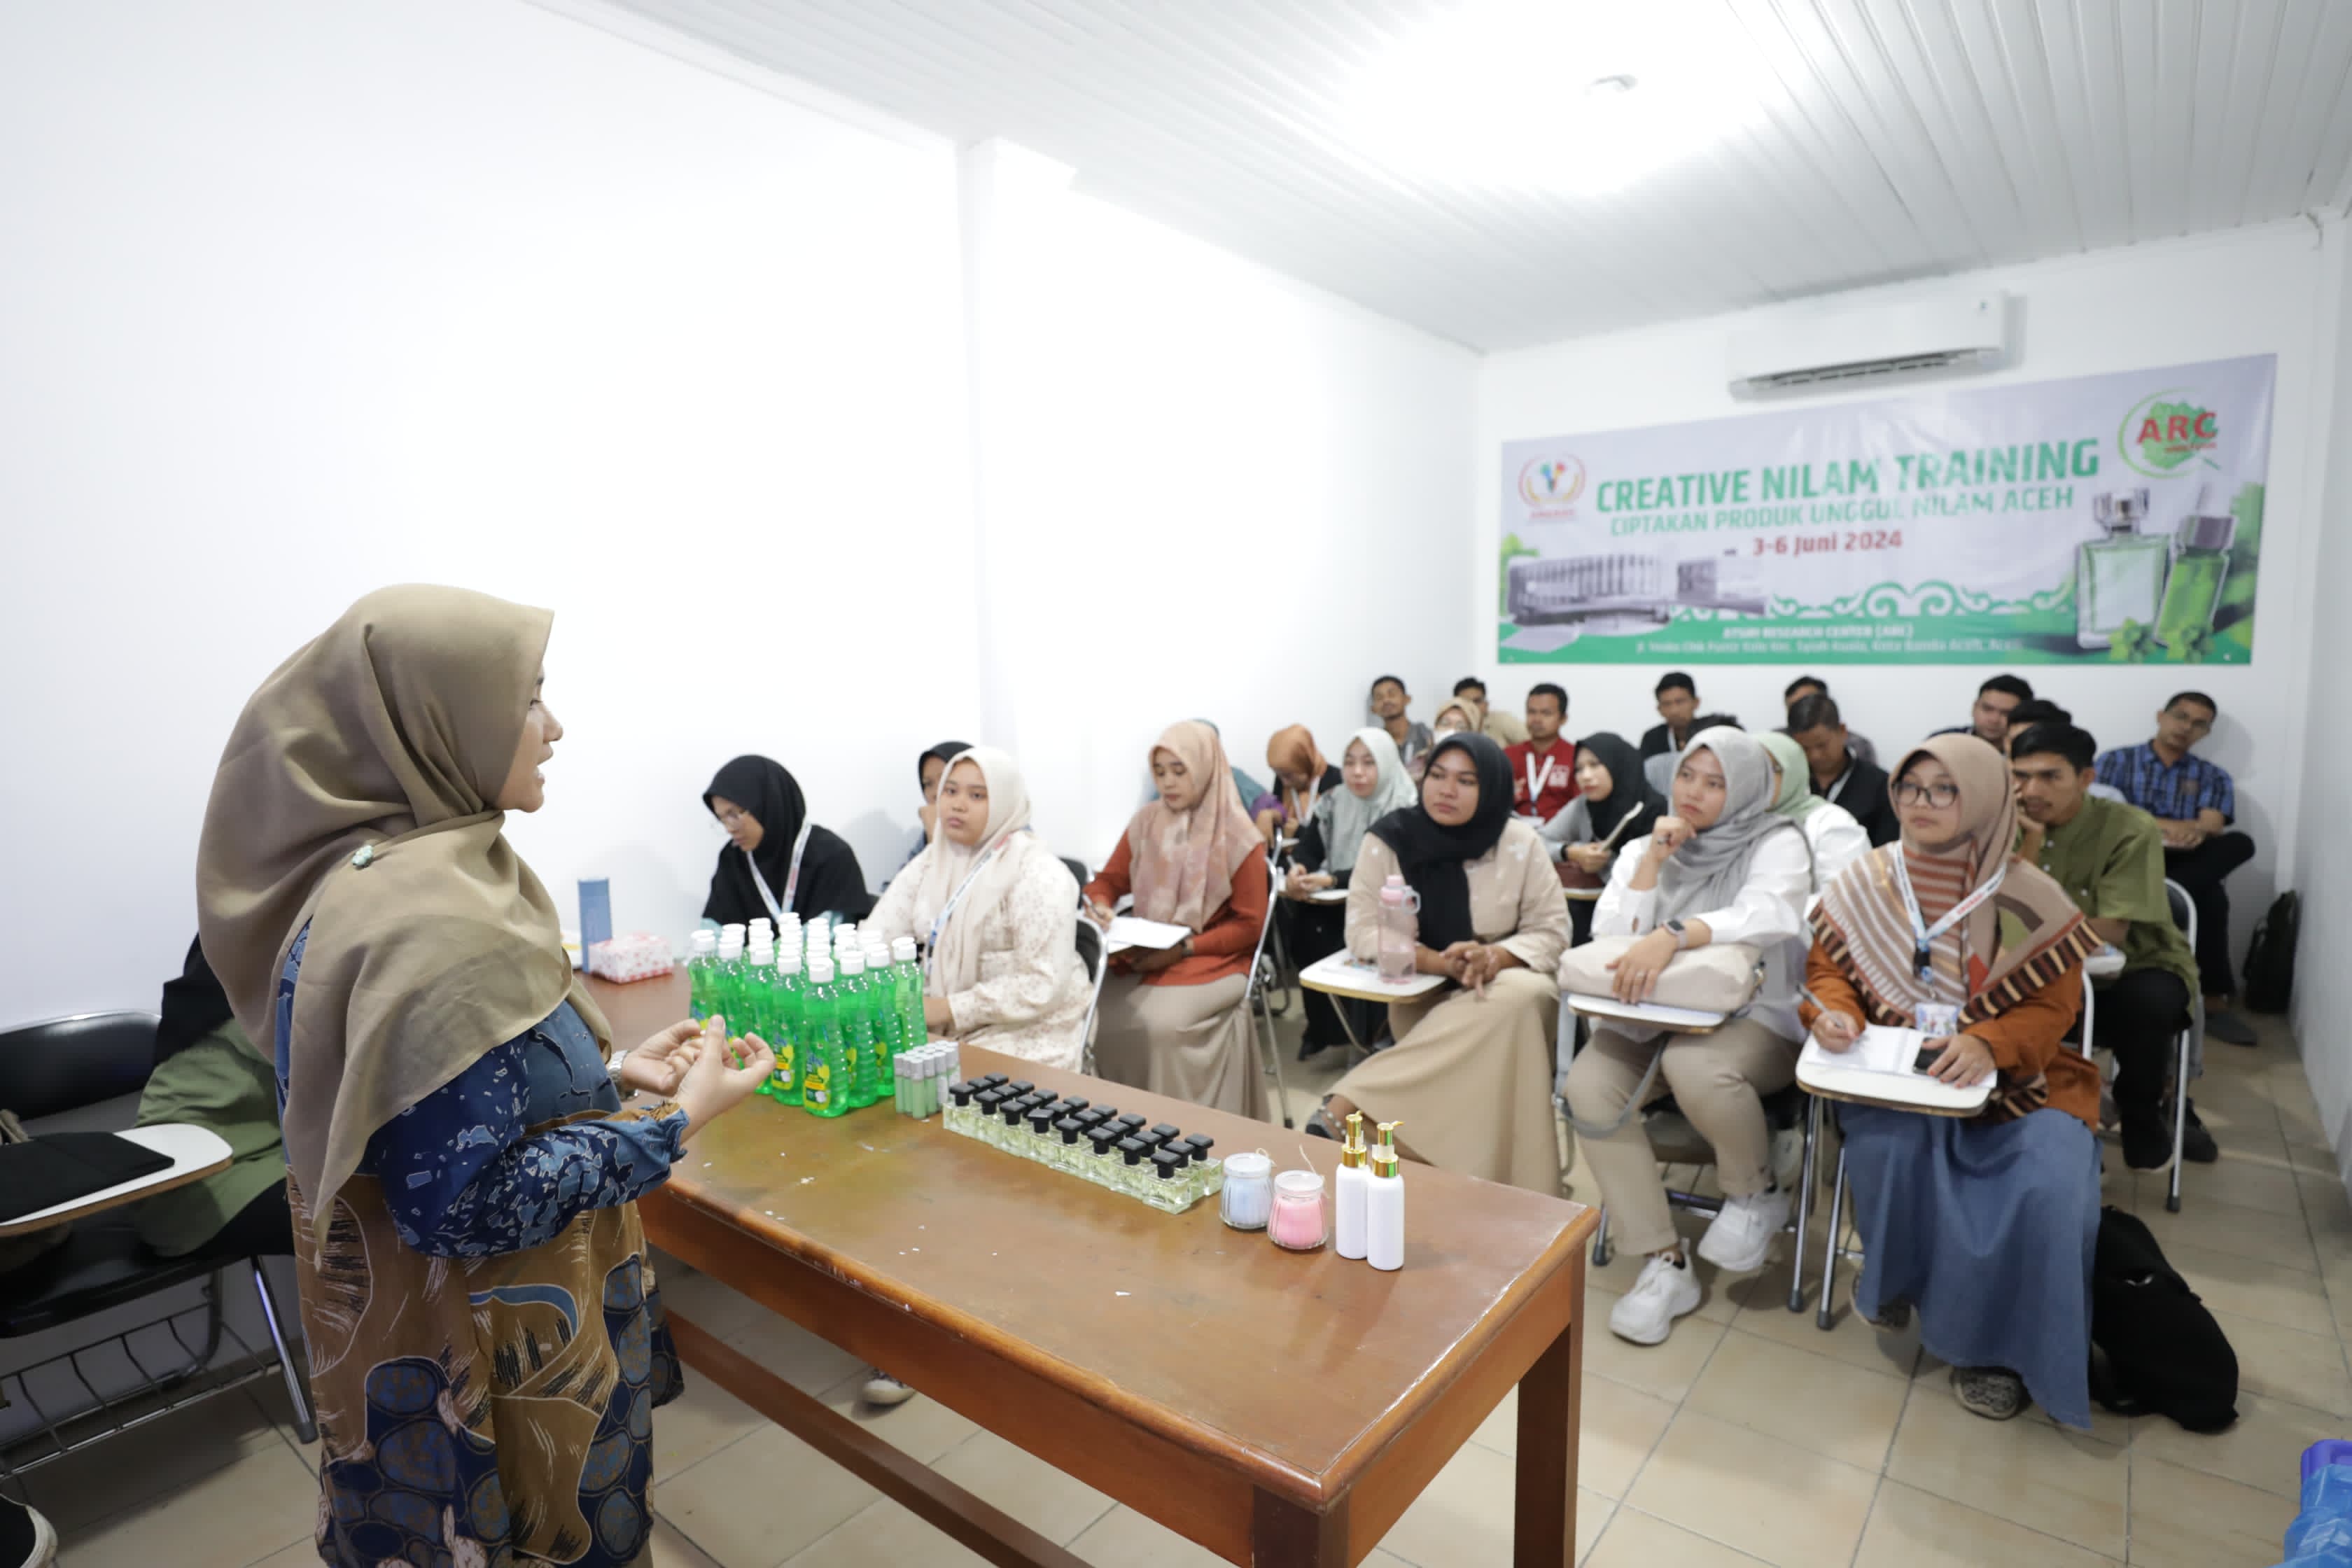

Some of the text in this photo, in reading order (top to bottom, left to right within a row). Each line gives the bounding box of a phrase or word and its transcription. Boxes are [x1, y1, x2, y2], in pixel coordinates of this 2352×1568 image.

[2136, 412, 2217, 444] ARC
[1597, 438, 2099, 512] CREATIVE NILAM TRAINING
[1611, 486, 2074, 536] CIPTAKAN PRODUK UNGGUL NILAM ACEH
[1753, 536, 1787, 556] 3-6
[1844, 529, 1903, 551] 2024
